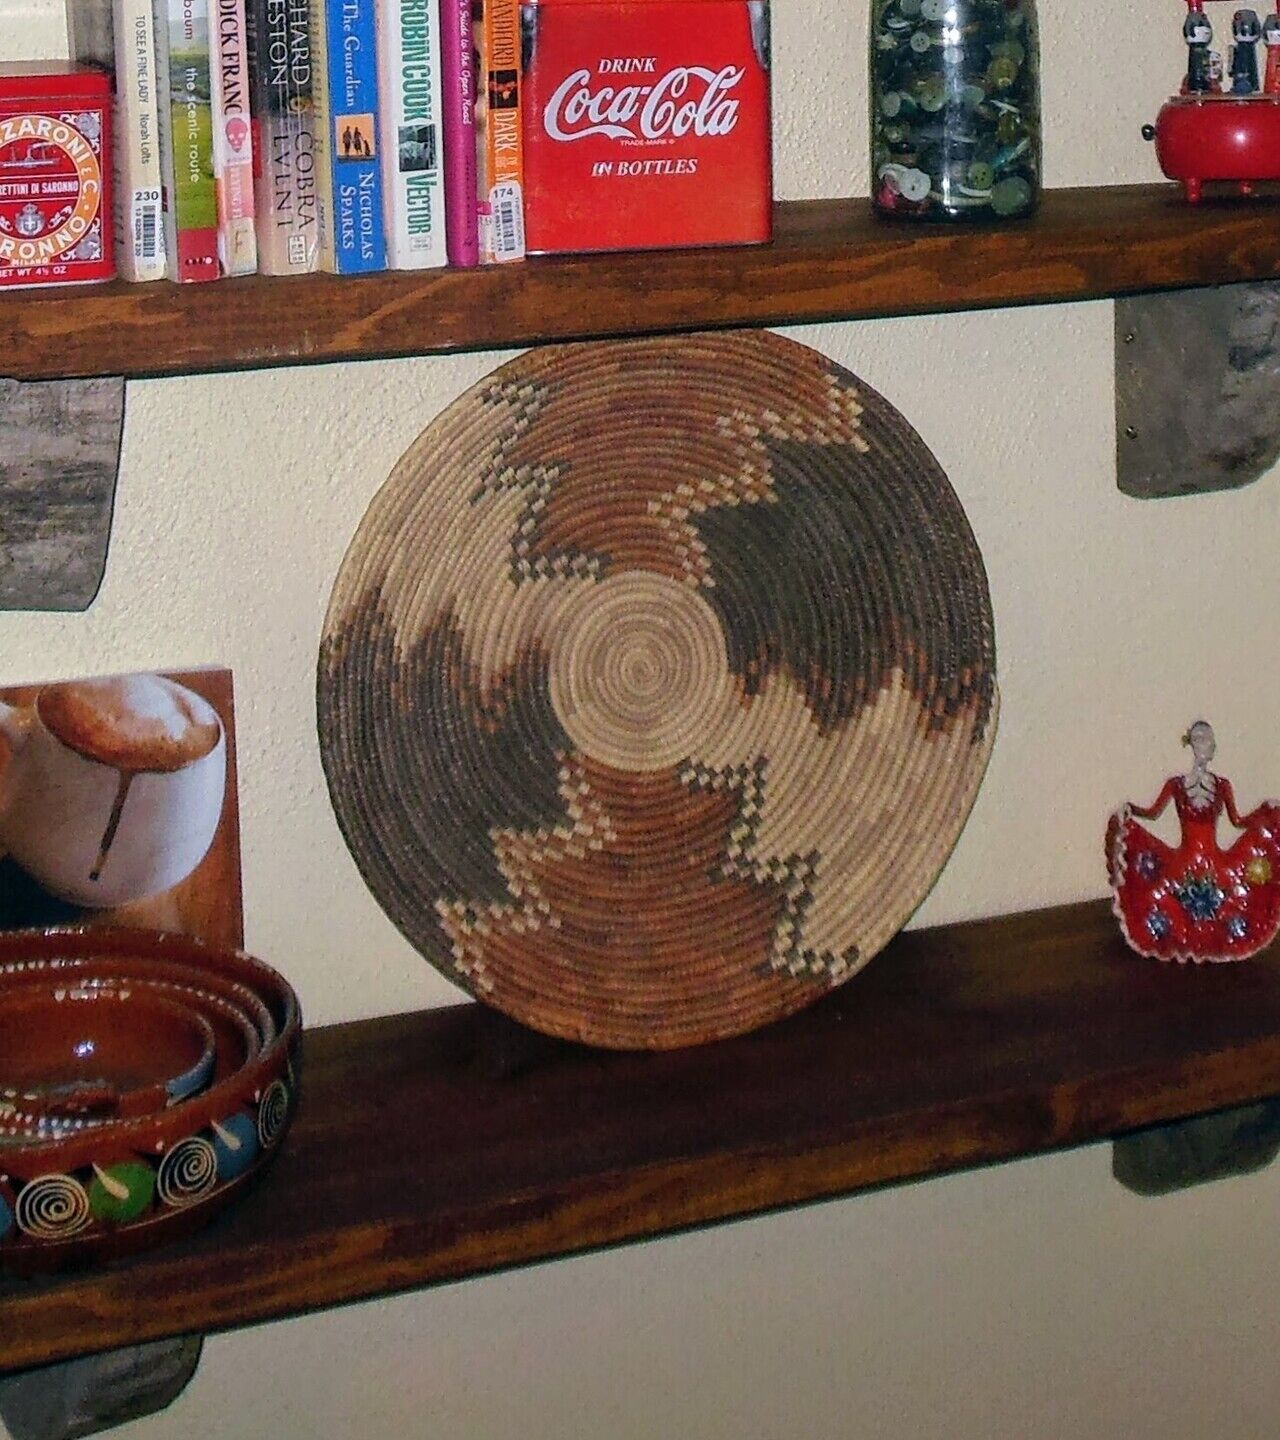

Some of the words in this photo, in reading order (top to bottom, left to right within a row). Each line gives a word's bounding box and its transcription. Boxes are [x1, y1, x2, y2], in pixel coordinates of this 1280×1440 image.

[135, 15, 146, 28] TO
[342, 0, 359, 32] The
[460, 10, 469, 37] Guide
[136, 30, 147, 46] SEE
[461, 39, 469, 49] to
[137, 57, 148, 77] FINE
[461, 51, 470, 66] the
[598, 57, 656, 73] DRINK
[185, 67, 198, 91] the
[344, 36, 362, 107] Guardian
[459, 70, 471, 95] Open
[138, 79, 150, 103] LADY
[222, 53, 242, 116] FRANC
[401, 65, 432, 122] COOK
[463, 98, 472, 125] Road
[544, 65, 746, 141] Coca-Cola
[139, 114, 151, 143] Norah
[187, 95, 200, 140] scenic
[494, 111, 518, 153] DARK
[141, 144, 151, 165] Lofts
[188, 144, 200, 184] route
[295, 131, 315, 230] COBRA
[591, 162, 612, 177] IN
[617, 159, 698, 176] BOTTLES
[31, 183, 40, 194] DI
[43, 180, 79, 193] SARONNO
[135, 191, 159, 201] 230
[494, 187, 513, 199] 174
[359, 172, 375, 260] NICHOLAS
[406, 172, 438, 235] VECTOR
[340, 185, 357, 250] SPARKS
[11, 257, 50, 267] MILANO
[17, 268, 32, 277] WT
[53, 265, 67, 274] OZ
